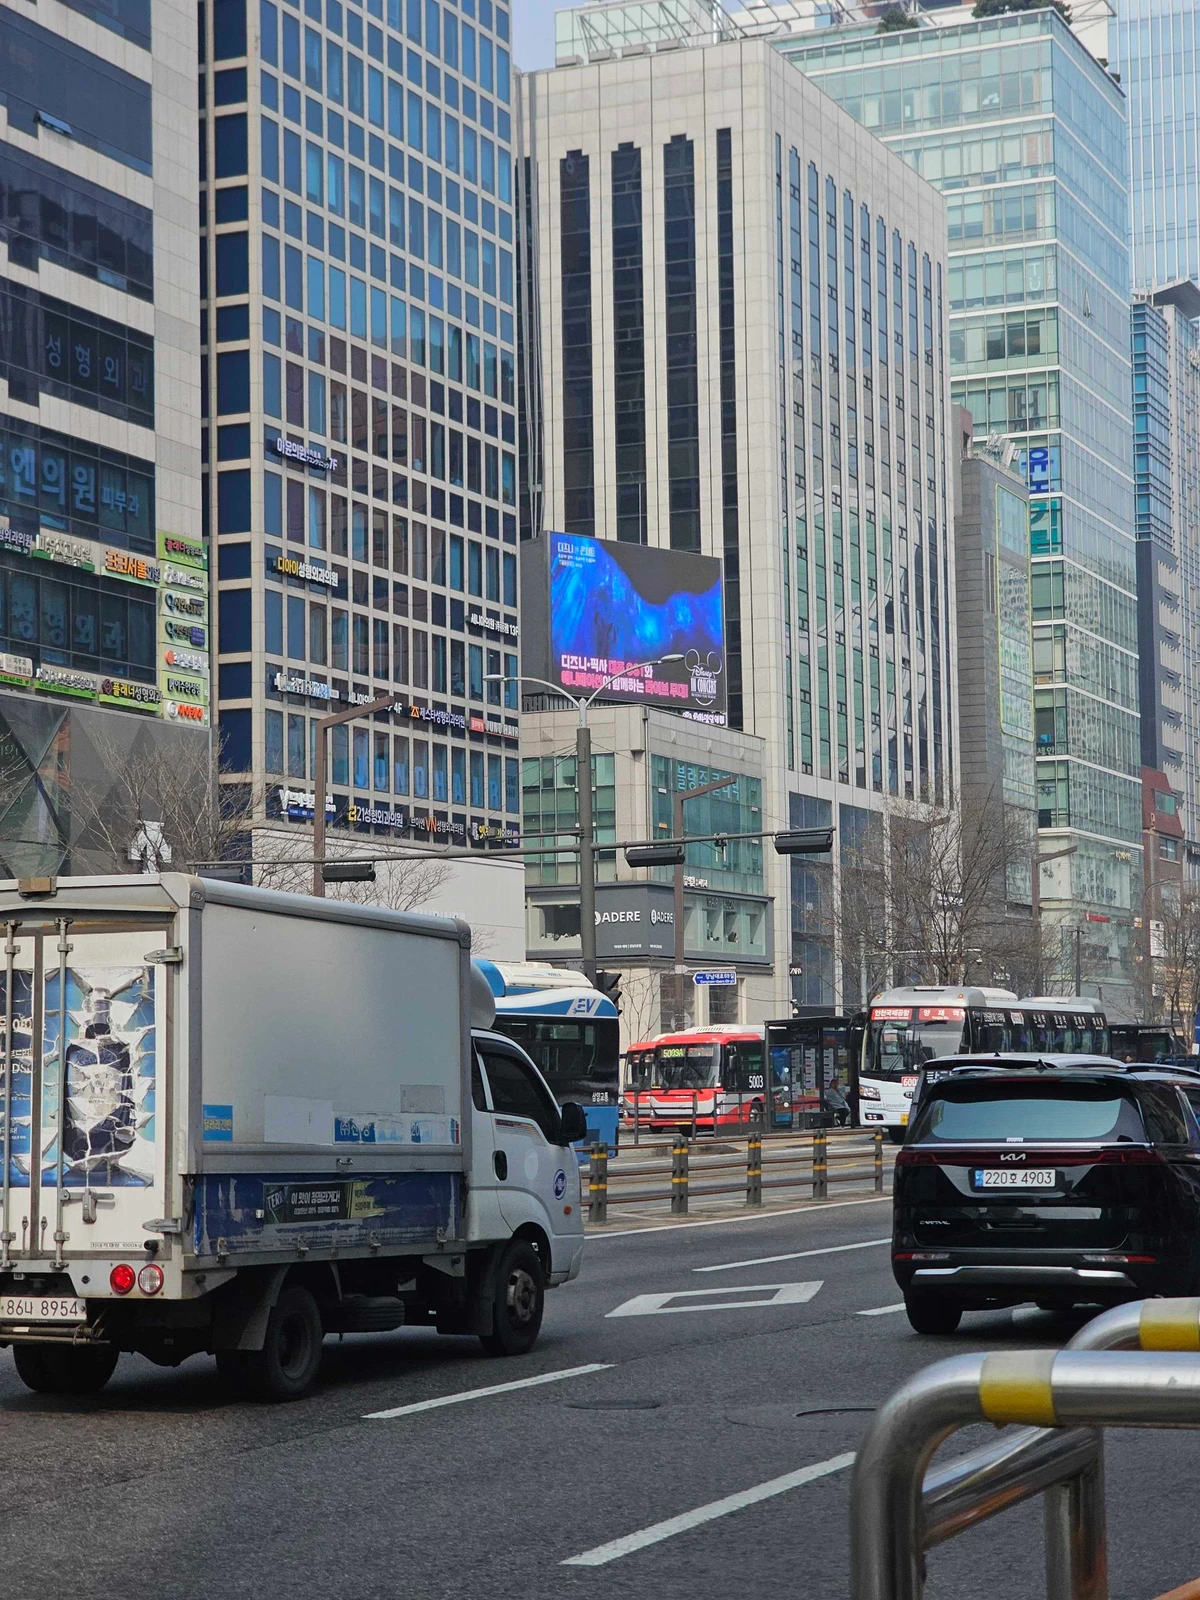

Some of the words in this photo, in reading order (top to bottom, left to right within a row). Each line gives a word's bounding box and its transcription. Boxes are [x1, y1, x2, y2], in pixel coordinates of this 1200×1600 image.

[577, 998, 597, 1014] EV
[748, 1075, 764, 1089] 5003
[985, 1171, 1018, 1185] 220호
[1021, 1171, 1052, 1185] 4903
[7, 1299, 33, 1316] 86나
[41, 1300, 78, 1317] 8954
